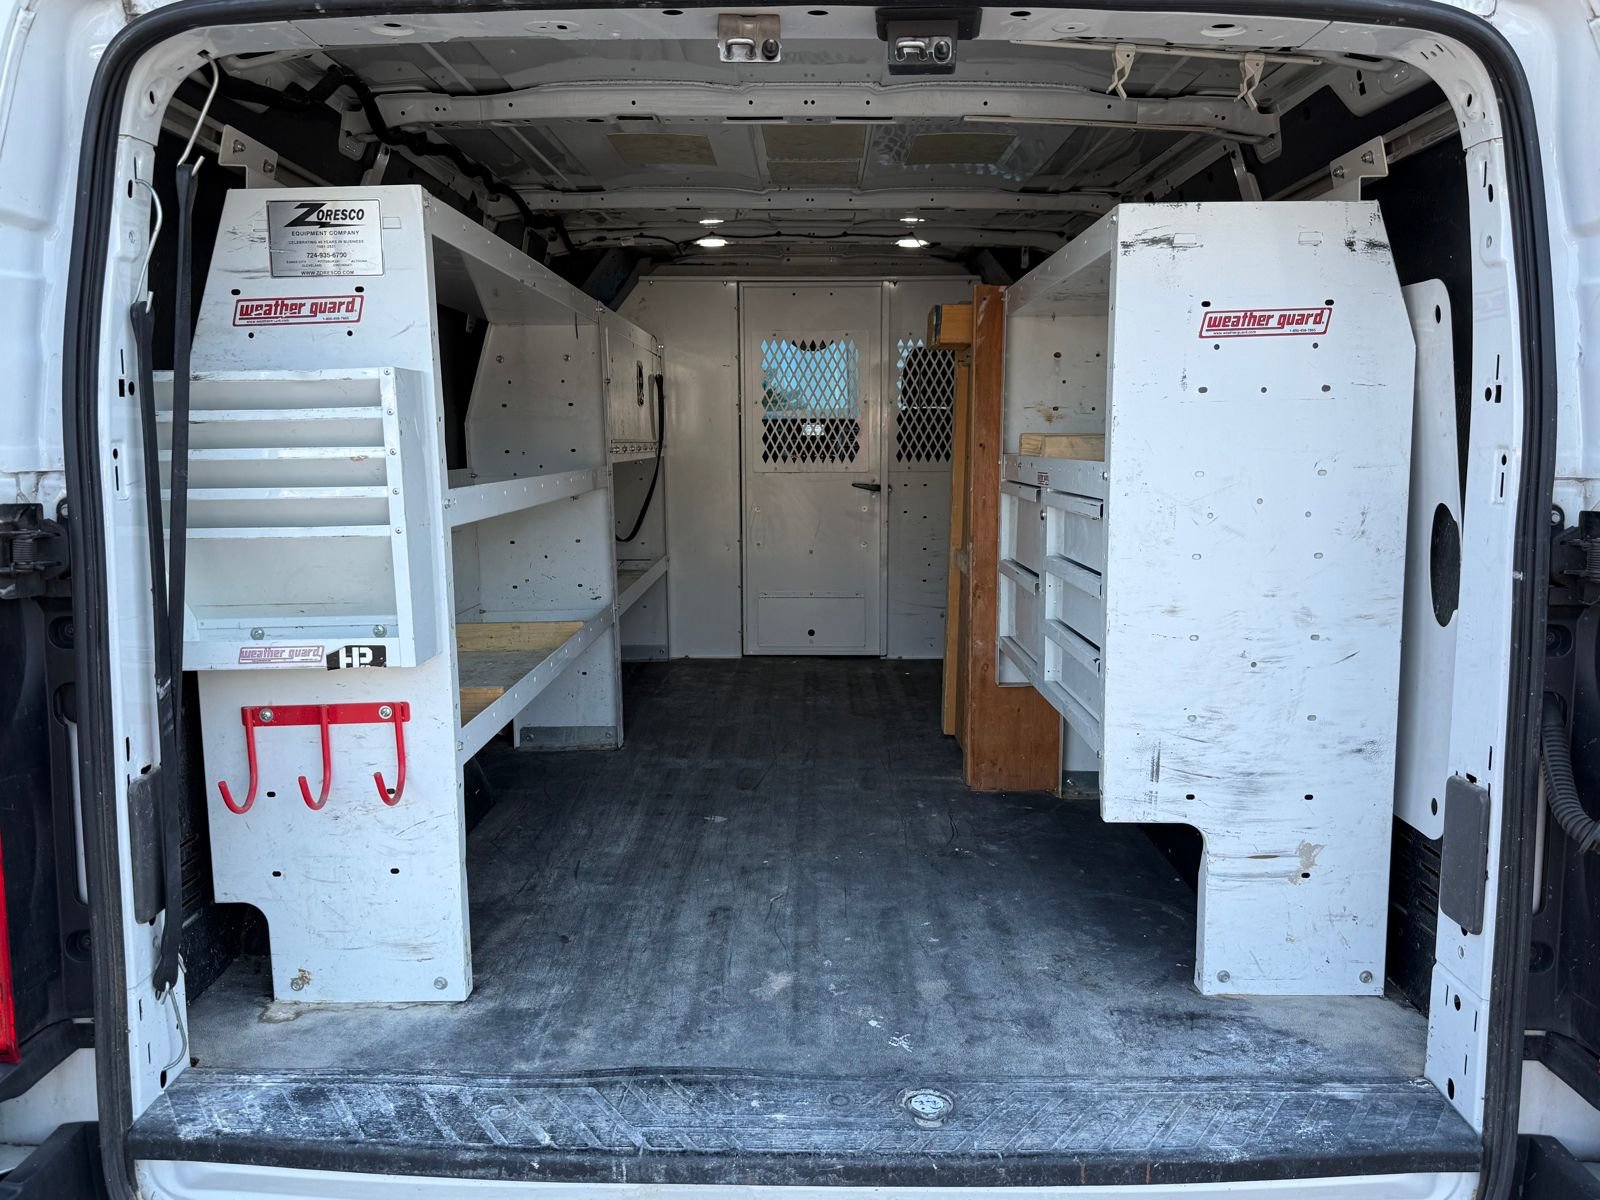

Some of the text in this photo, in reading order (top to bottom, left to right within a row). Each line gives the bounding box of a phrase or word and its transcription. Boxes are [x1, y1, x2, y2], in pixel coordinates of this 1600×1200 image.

[283, 203, 365, 228] ZORESCO
[239, 297, 356, 318] weather guard
[1206, 309, 1324, 329] weather guard
[240, 646, 322, 660] weather guard
